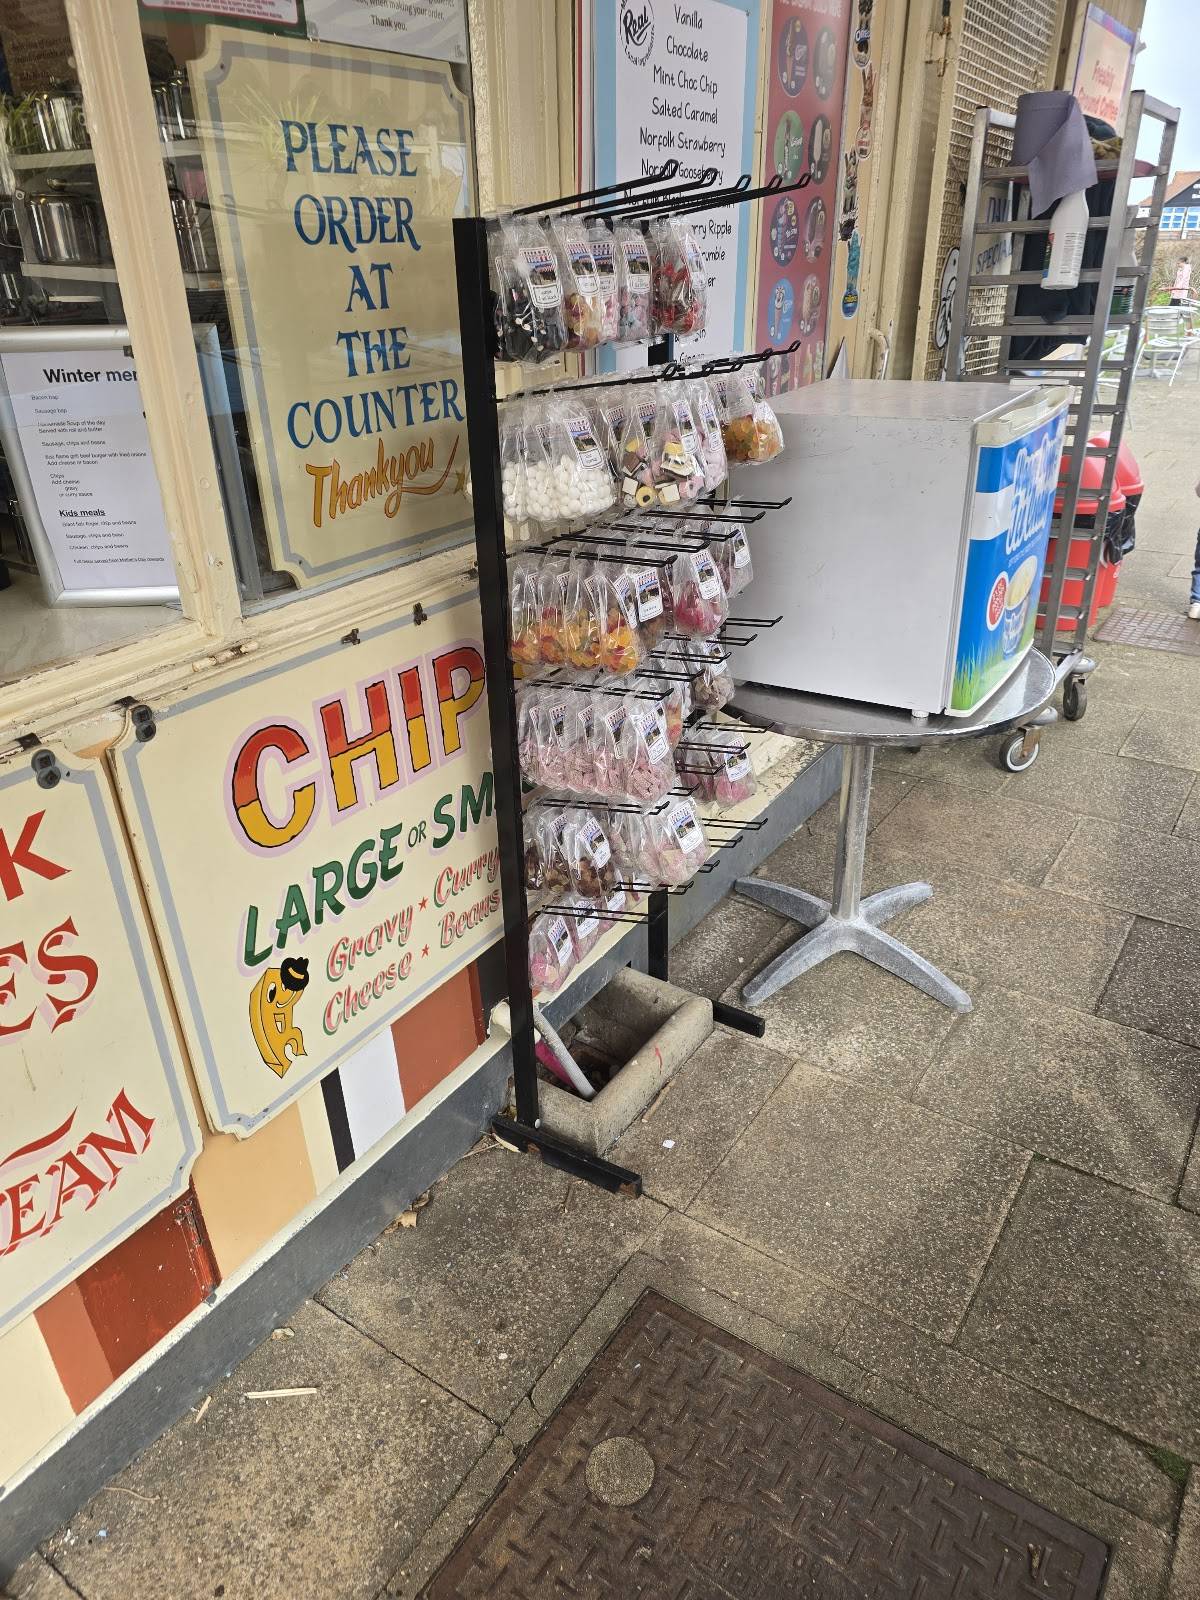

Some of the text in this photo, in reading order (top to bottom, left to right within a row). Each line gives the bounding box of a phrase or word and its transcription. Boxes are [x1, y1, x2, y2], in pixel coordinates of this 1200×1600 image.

[370, 15, 408, 31] Thank you.
[388, 1, 412, 16] making
[412, 6, 429, 16] your
[623, 5, 651, 46] Real
[674, 4, 703, 30] Vanilla
[666, 35, 709, 62] Chocolate
[653, 64, 718, 100] Mint Choc Chip
[652, 96, 718, 124] Salted Caramel
[280, 119, 418, 177] PLEASE
[639, 126, 726, 158] Norfolk Strawberry
[294, 193, 422, 254] ORDER
[709, 219, 732, 240] Ripple
[345, 262, 394, 313] AT
[336, 326, 411, 378] THE
[43, 368, 101, 383] Winter
[287, 378, 466, 449] COUNTER
[59, 508, 106, 518] Kids meals
[231, 646, 486, 848] CHIP
[0, 809, 72, 901] K
[244, 771, 494, 966] LARGE OR SM
[326, 846, 500, 982] Gravy Curry
[323, 888, 501, 1035] Cheese Beans
[0, 1087, 156, 1258] EAM
